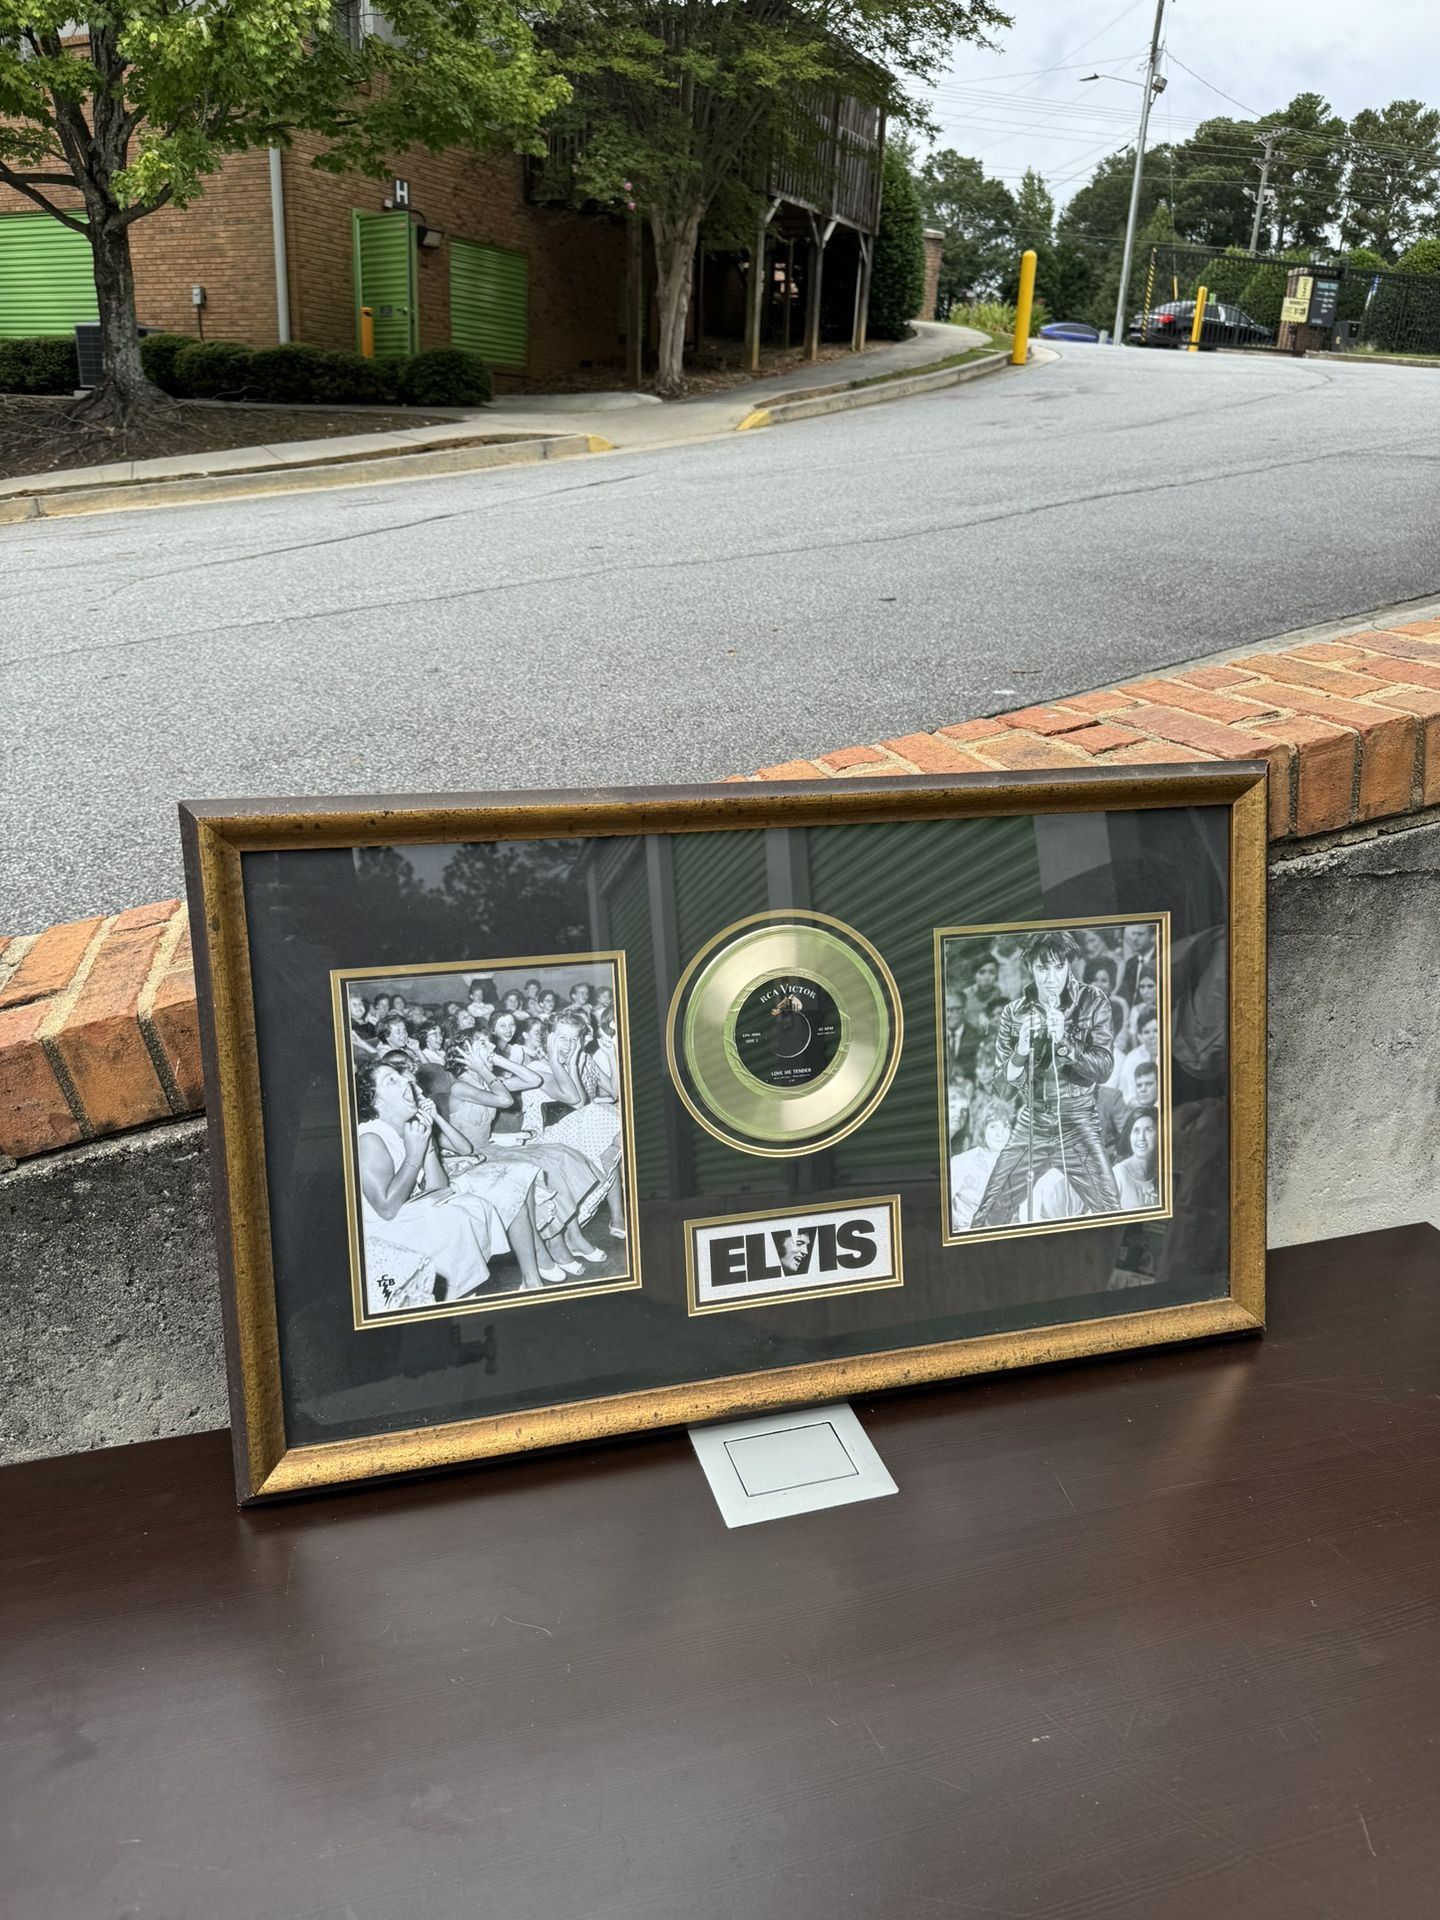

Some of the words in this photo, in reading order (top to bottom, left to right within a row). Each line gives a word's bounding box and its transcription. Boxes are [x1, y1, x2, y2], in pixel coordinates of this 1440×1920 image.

[395, 180, 409, 204] H
[759, 990, 779, 1003] RCA
[779, 983, 818, 1000] VICTOR
[709, 1219, 878, 1287] ELVIS
